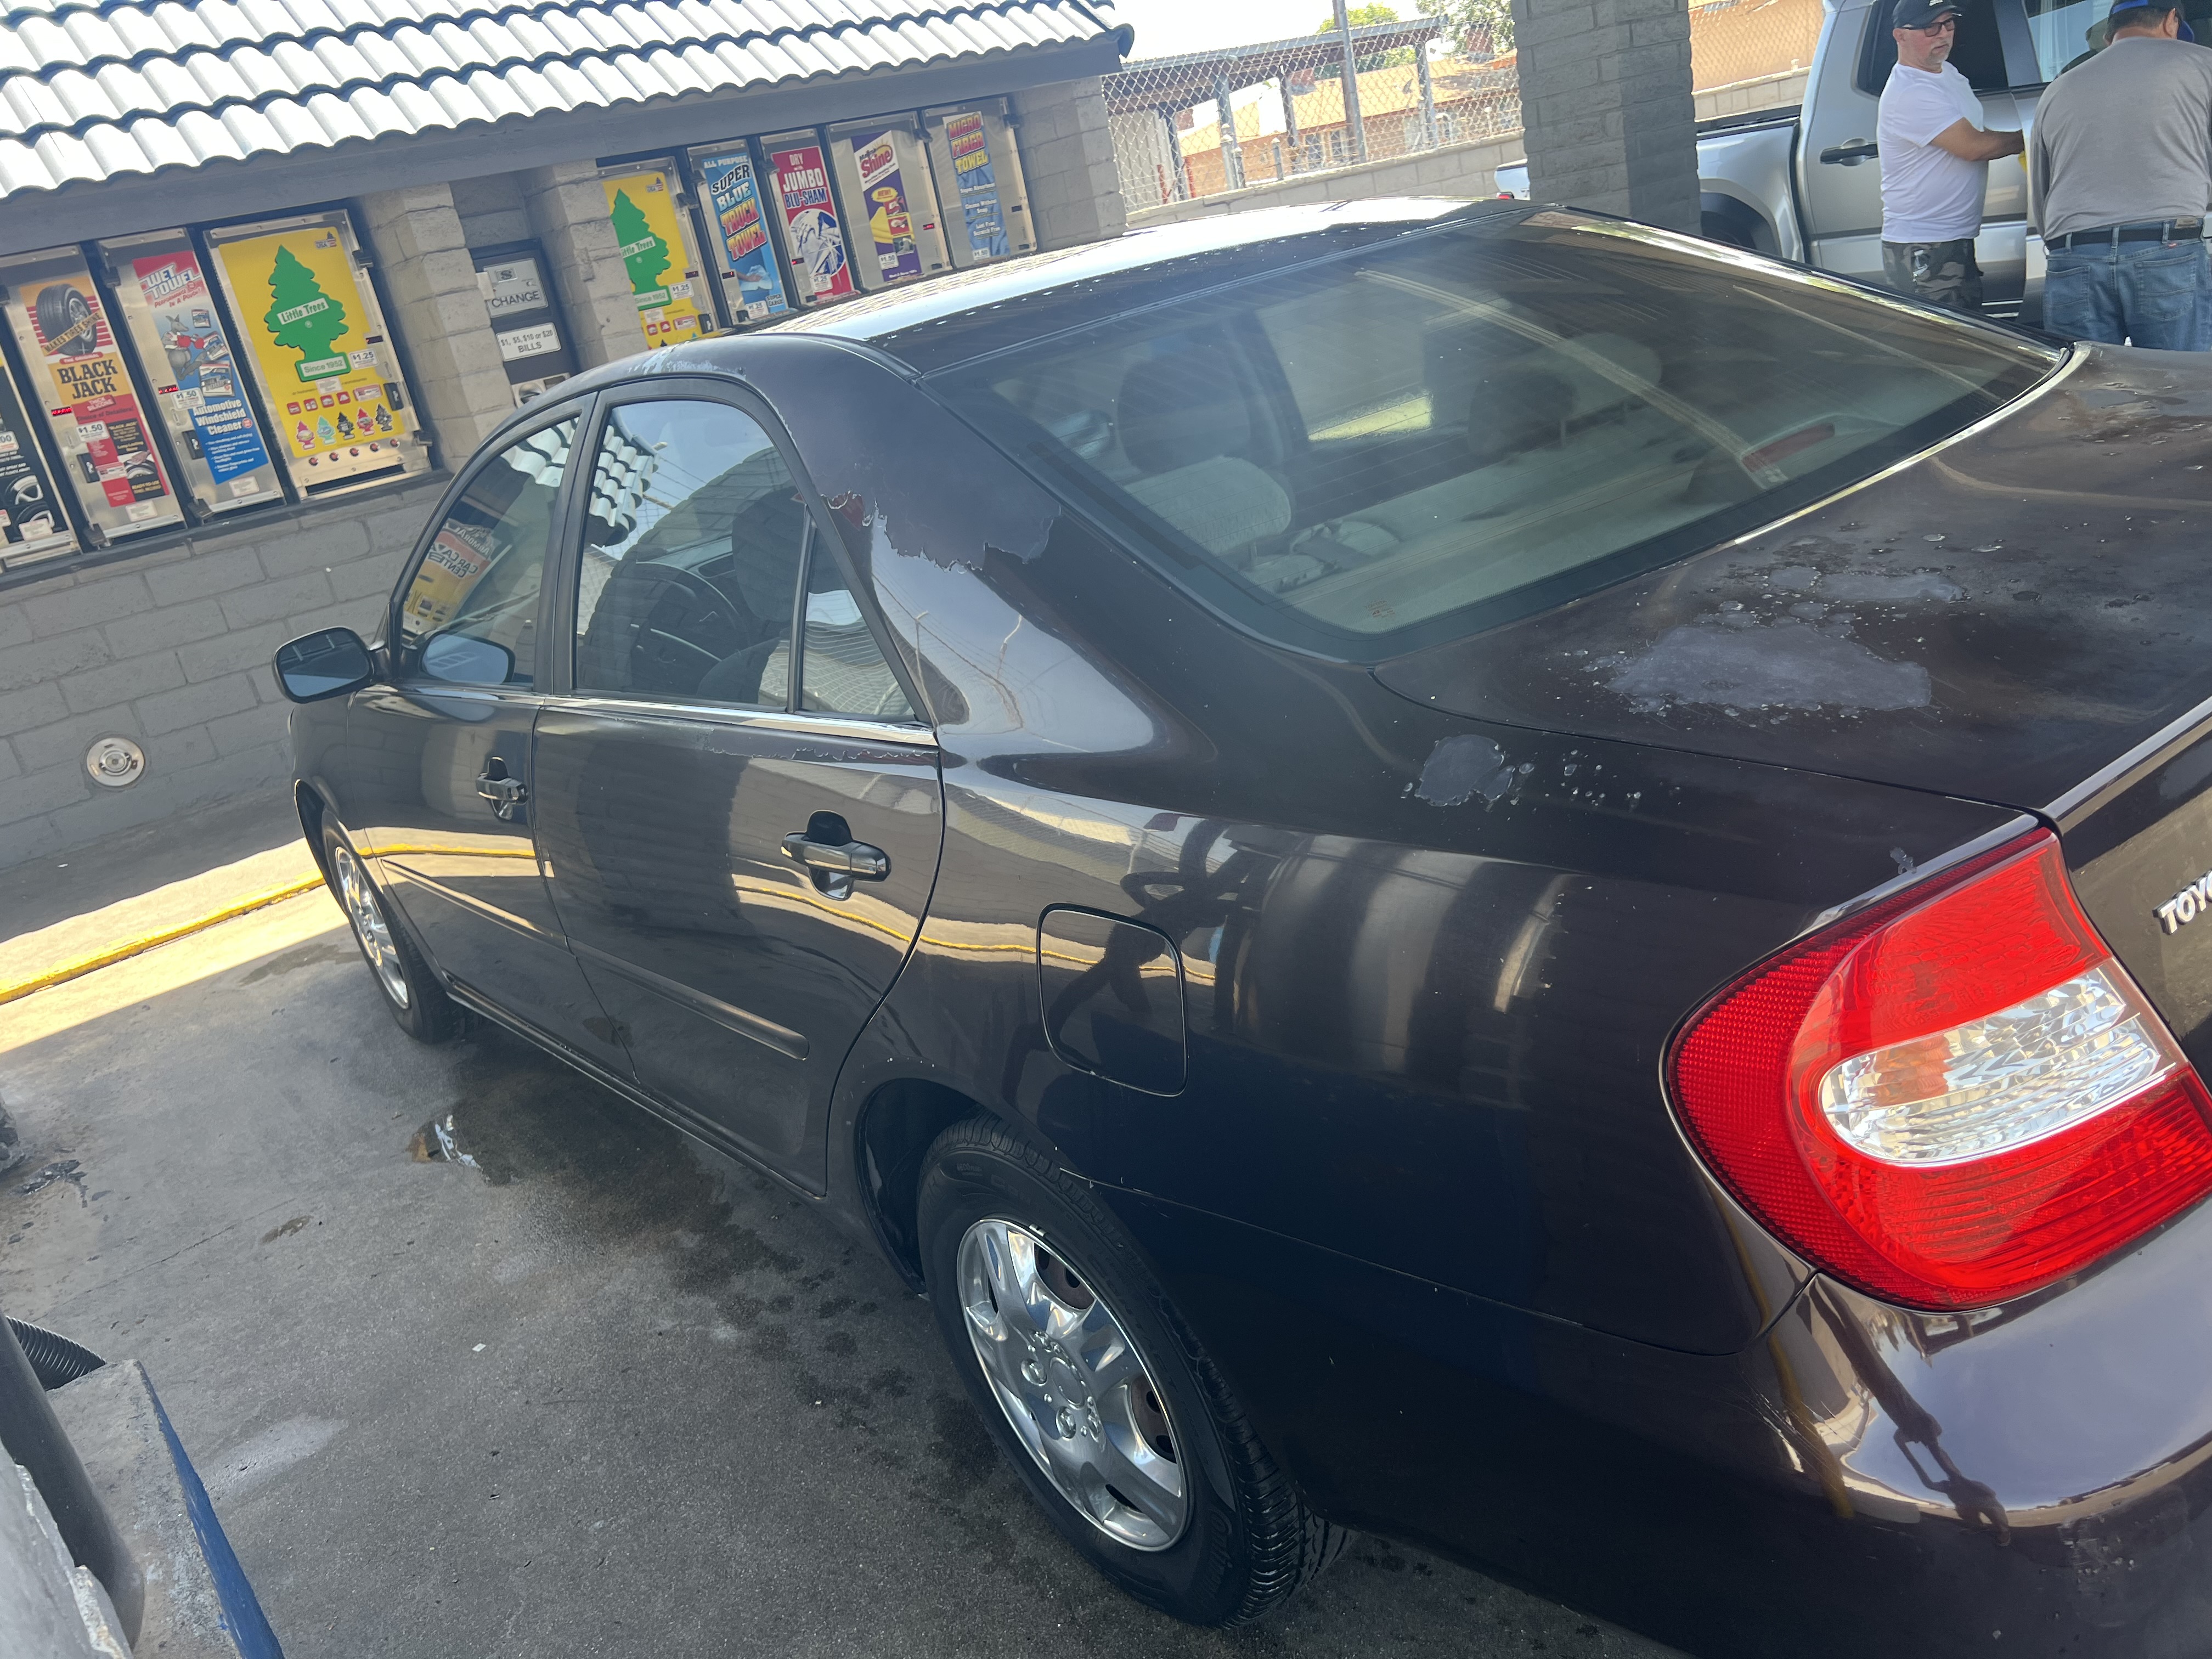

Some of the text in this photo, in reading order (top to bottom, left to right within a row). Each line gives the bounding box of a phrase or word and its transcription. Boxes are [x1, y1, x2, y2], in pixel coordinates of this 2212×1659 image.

[948, 114, 980, 139] MICRO
[952, 131, 984, 157] FIBER
[718, 155, 748, 166] PURPOSE
[789, 153, 803, 166] DRY
[861, 151, 891, 178] Shine
[956, 150, 988, 174] TOWEL
[712, 165, 750, 193] SUPER
[783, 168, 823, 192] JUMBO
[716, 181, 752, 212] BLUE
[784, 188, 827, 208] BLU-SHAM
[720, 198, 759, 235] TRUCK
[622, 240, 653, 256] ittle Trees
[727, 223, 766, 260] TOWEL
[147, 264, 175, 286] WET
[151, 269, 196, 299] TOWEL
[492, 291, 540, 308] CHANGE
[281, 301, 325, 323] Little Trees
[44, 335, 66, 353] MAKES
[524, 333, 534, 341] $10
[543, 330, 553, 338] $20
[353, 351, 374, 360] $1.25
[518, 342, 542, 353] BILLS
[57, 359, 118, 384] BLACK
[304, 360, 343, 373] Since 1952
[72, 377, 117, 399] JACK
[176, 390, 197, 399] $1.50
[194, 399, 242, 416] Automotive
[196, 408, 246, 426] Windshield
[78, 424, 103, 433] $1.50
[207, 421, 242, 435] Cleaner
